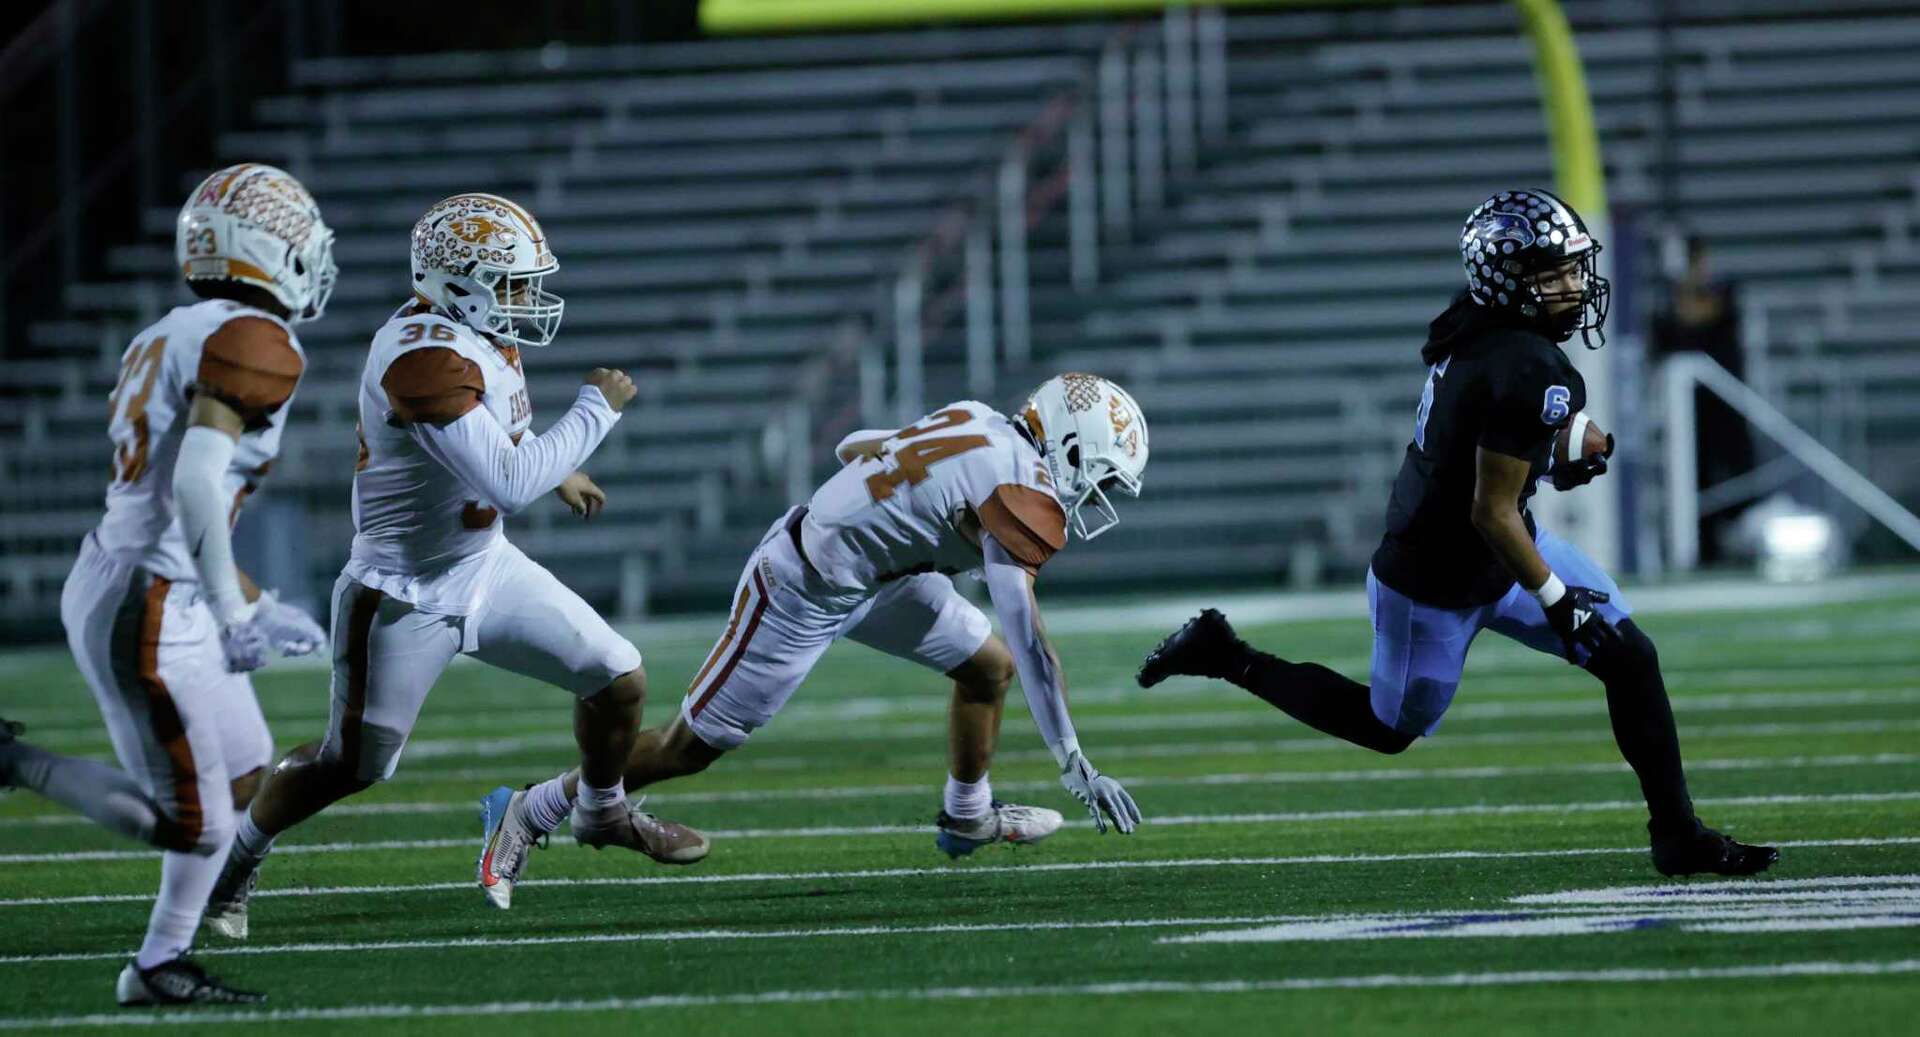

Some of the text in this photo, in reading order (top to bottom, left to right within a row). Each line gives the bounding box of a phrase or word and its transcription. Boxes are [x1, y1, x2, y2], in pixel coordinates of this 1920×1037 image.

[187, 226, 217, 255] 23
[398, 322, 457, 345] 36
[1540, 385, 1570, 425] 6
[864, 408, 994, 502] 24
